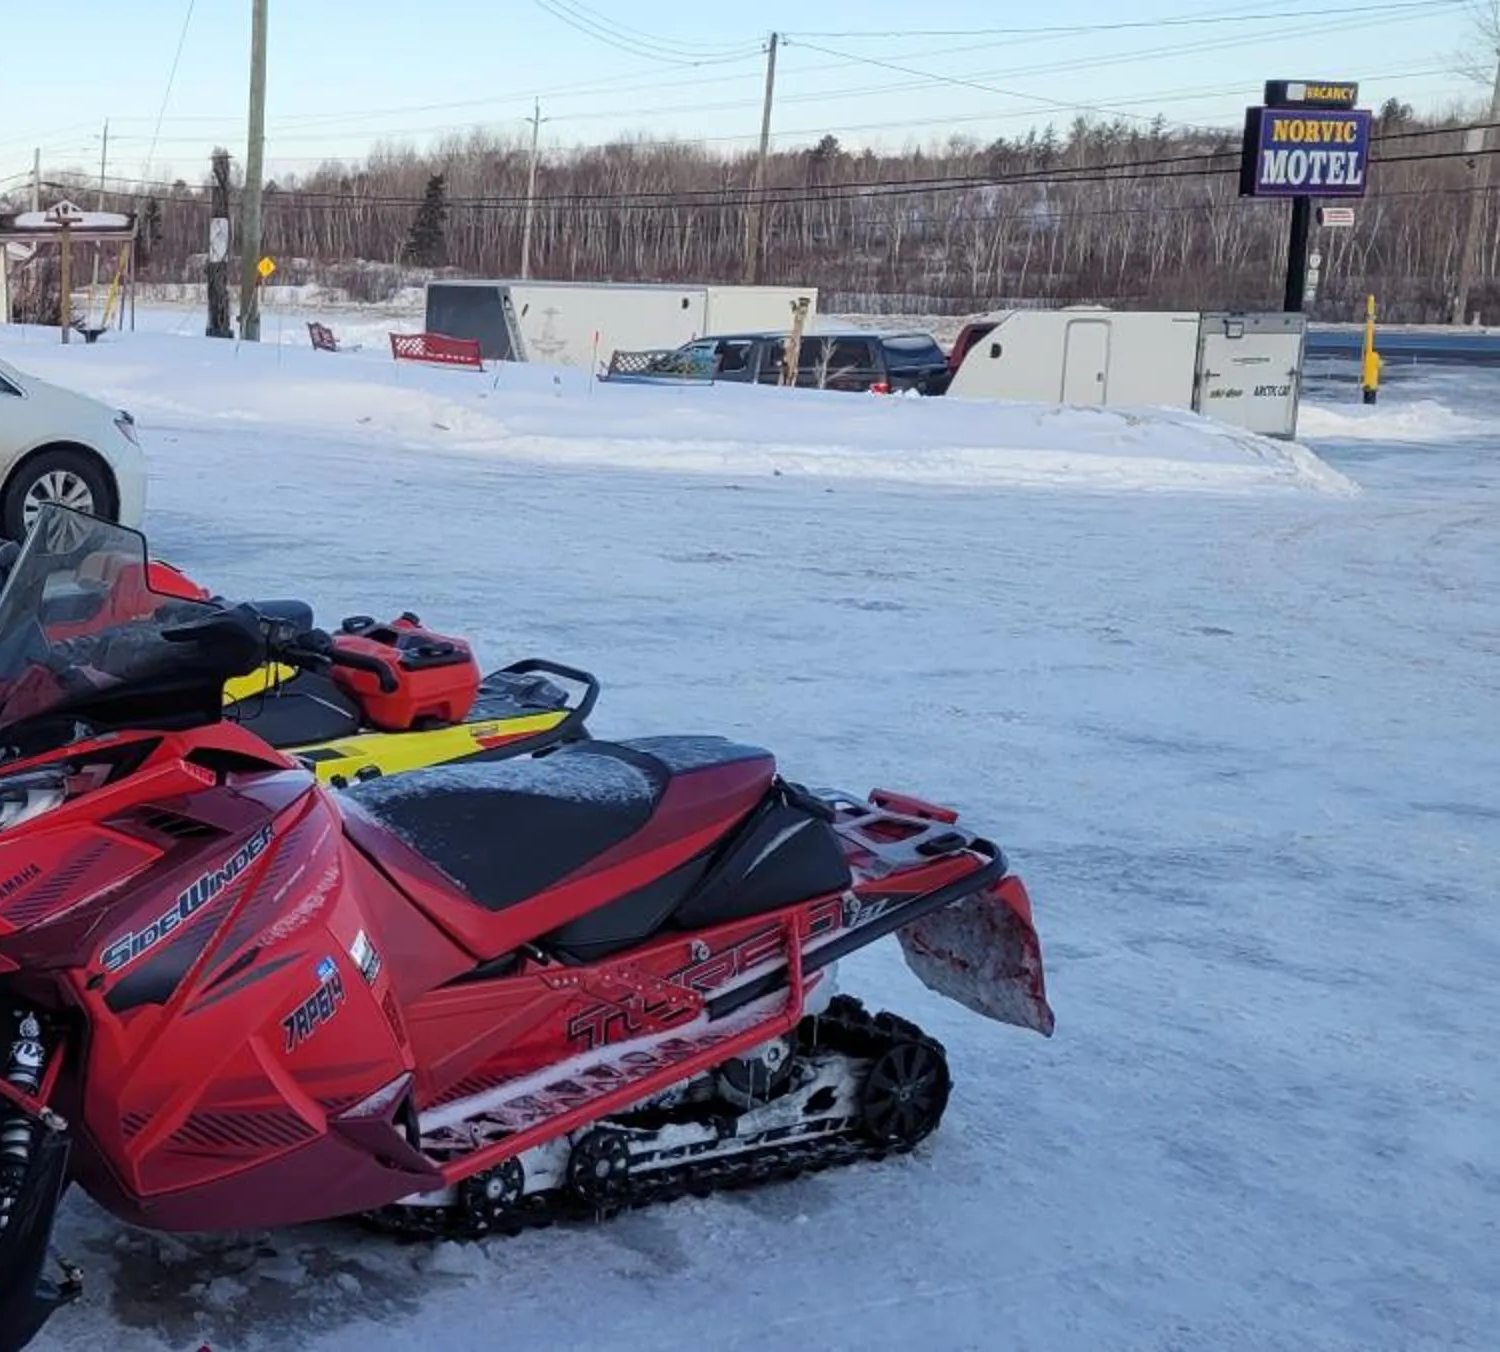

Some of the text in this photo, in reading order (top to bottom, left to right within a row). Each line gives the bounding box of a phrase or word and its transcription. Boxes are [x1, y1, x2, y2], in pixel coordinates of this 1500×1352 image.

[1306, 86, 1355, 100] VACANCY
[1272, 118, 1358, 145] NORVIC
[1259, 149, 1363, 186] MOTEL
